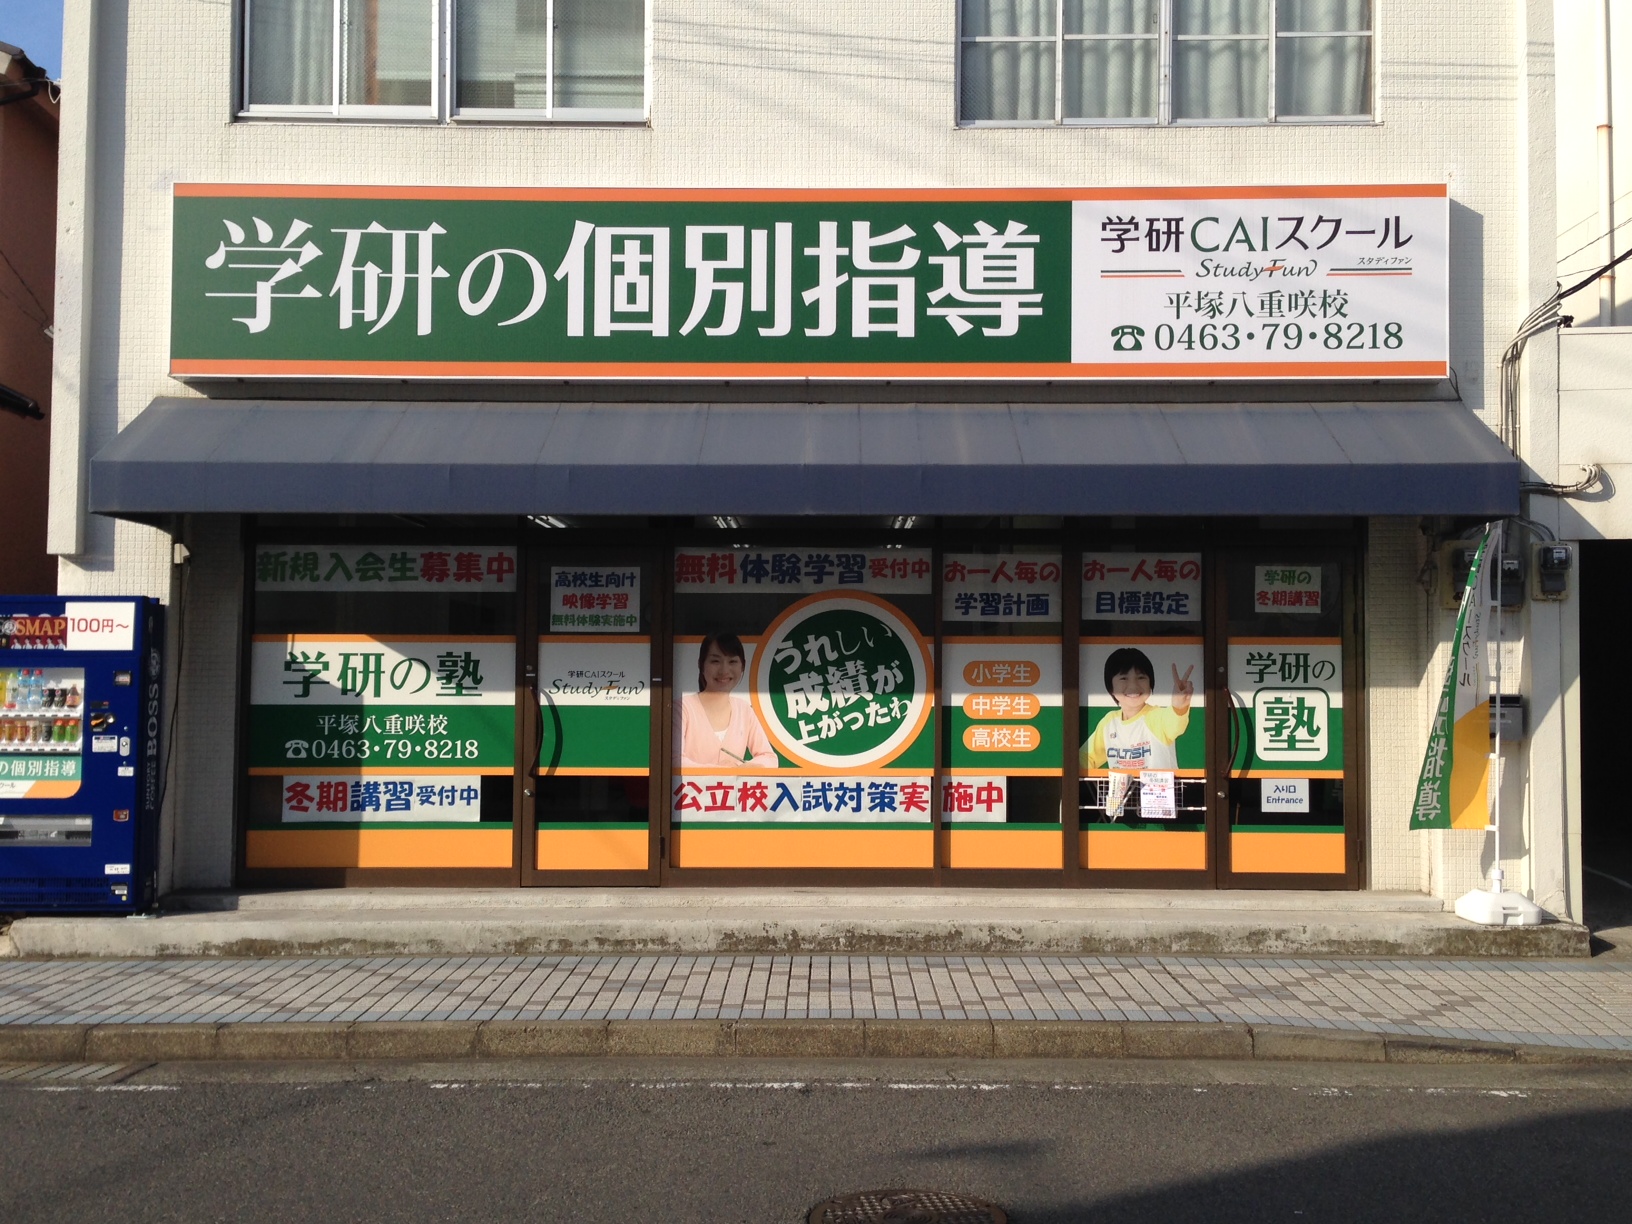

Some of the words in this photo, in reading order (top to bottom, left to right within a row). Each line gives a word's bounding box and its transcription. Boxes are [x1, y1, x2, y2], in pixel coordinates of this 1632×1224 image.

[1100, 214, 1413, 253] 学研CAIスクール
[1356, 256, 1413, 266] スタディファン
[205, 216, 1043, 337] 学研の個別指導
[1163, 289, 1349, 320] 平塚八重咲校
[256, 552, 515, 583] 新規入会生募集中
[554, 570, 637, 588] 高校生向け
[675, 551, 931, 585] 無料体験学習受付中
[943, 559, 1061, 584] お一人毎の
[1083, 557, 1201, 583] お一人毎の
[1264, 569, 1312, 586] 学研の
[562, 593, 629, 610] 映像学習
[954, 592, 1050, 617] 学習計画
[1095, 591, 1190, 615] 目標設定
[1256, 590, 1320, 607] 冬期講習
[15, 618, 66, 636] SMAP
[551, 614, 637, 627] 無料体験実施中
[774, 624, 893, 675] うれしい
[283, 650, 485, 698] 学研の塾
[567, 670, 626, 679] 学研CAIスクール
[970, 663, 1032, 684] 小学生
[1246, 651, 1336, 684] 学研の
[783, 659, 904, 720] 成績が
[970, 695, 1032, 716] 中学生
[146, 682, 159, 758] BOSS
[316, 713, 449, 736] 平塚八重咲校
[797, 696, 912, 746] 上がったわ
[1263, 697, 1322, 752] 塾
[970, 727, 1032, 749] 高校生
[284, 781, 480, 812] 冬期講習受付中
[1266, 796, 1304, 805] Entrance
[1273, 784, 1297, 794] 入り口
